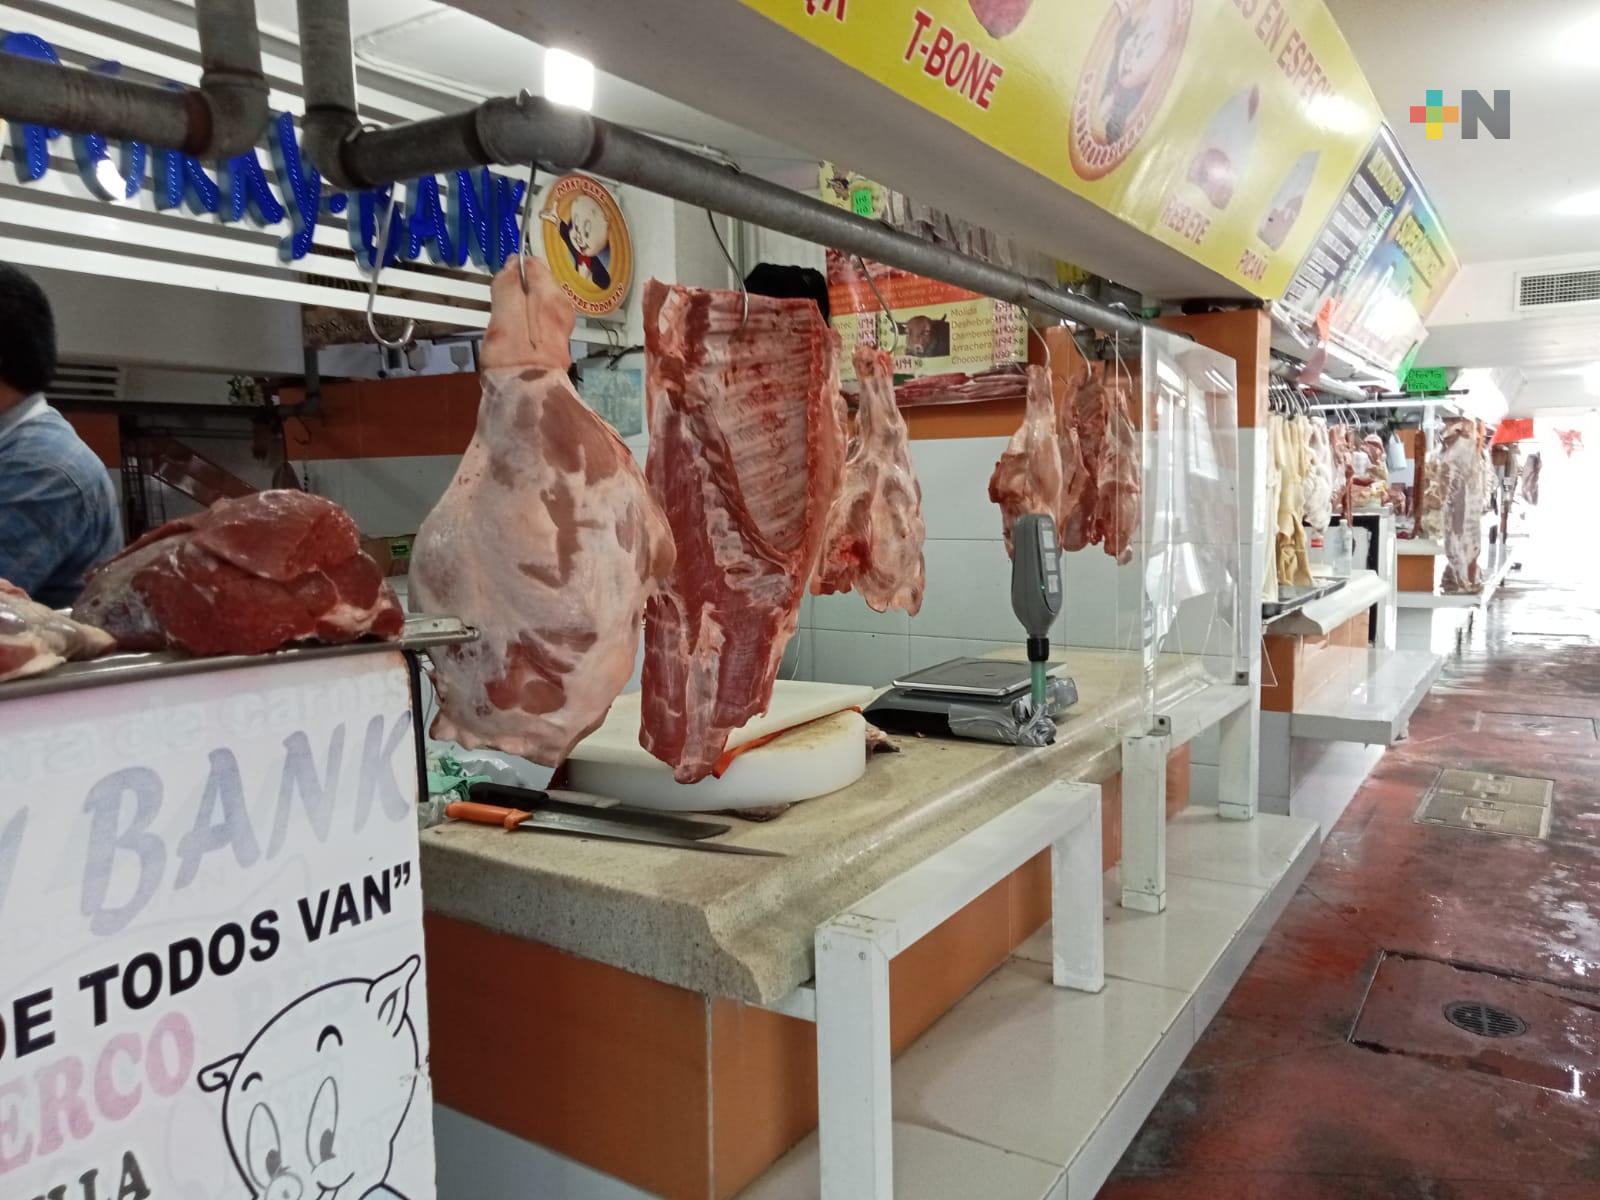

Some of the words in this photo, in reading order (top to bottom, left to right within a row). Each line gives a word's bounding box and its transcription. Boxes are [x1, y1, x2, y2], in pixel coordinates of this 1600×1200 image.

[905, 10, 1003, 109] T-BONE
[951, 315, 993, 328] Deshebra
[80, 711, 412, 937] BANK
[79, 909, 281, 1028] TODOS
